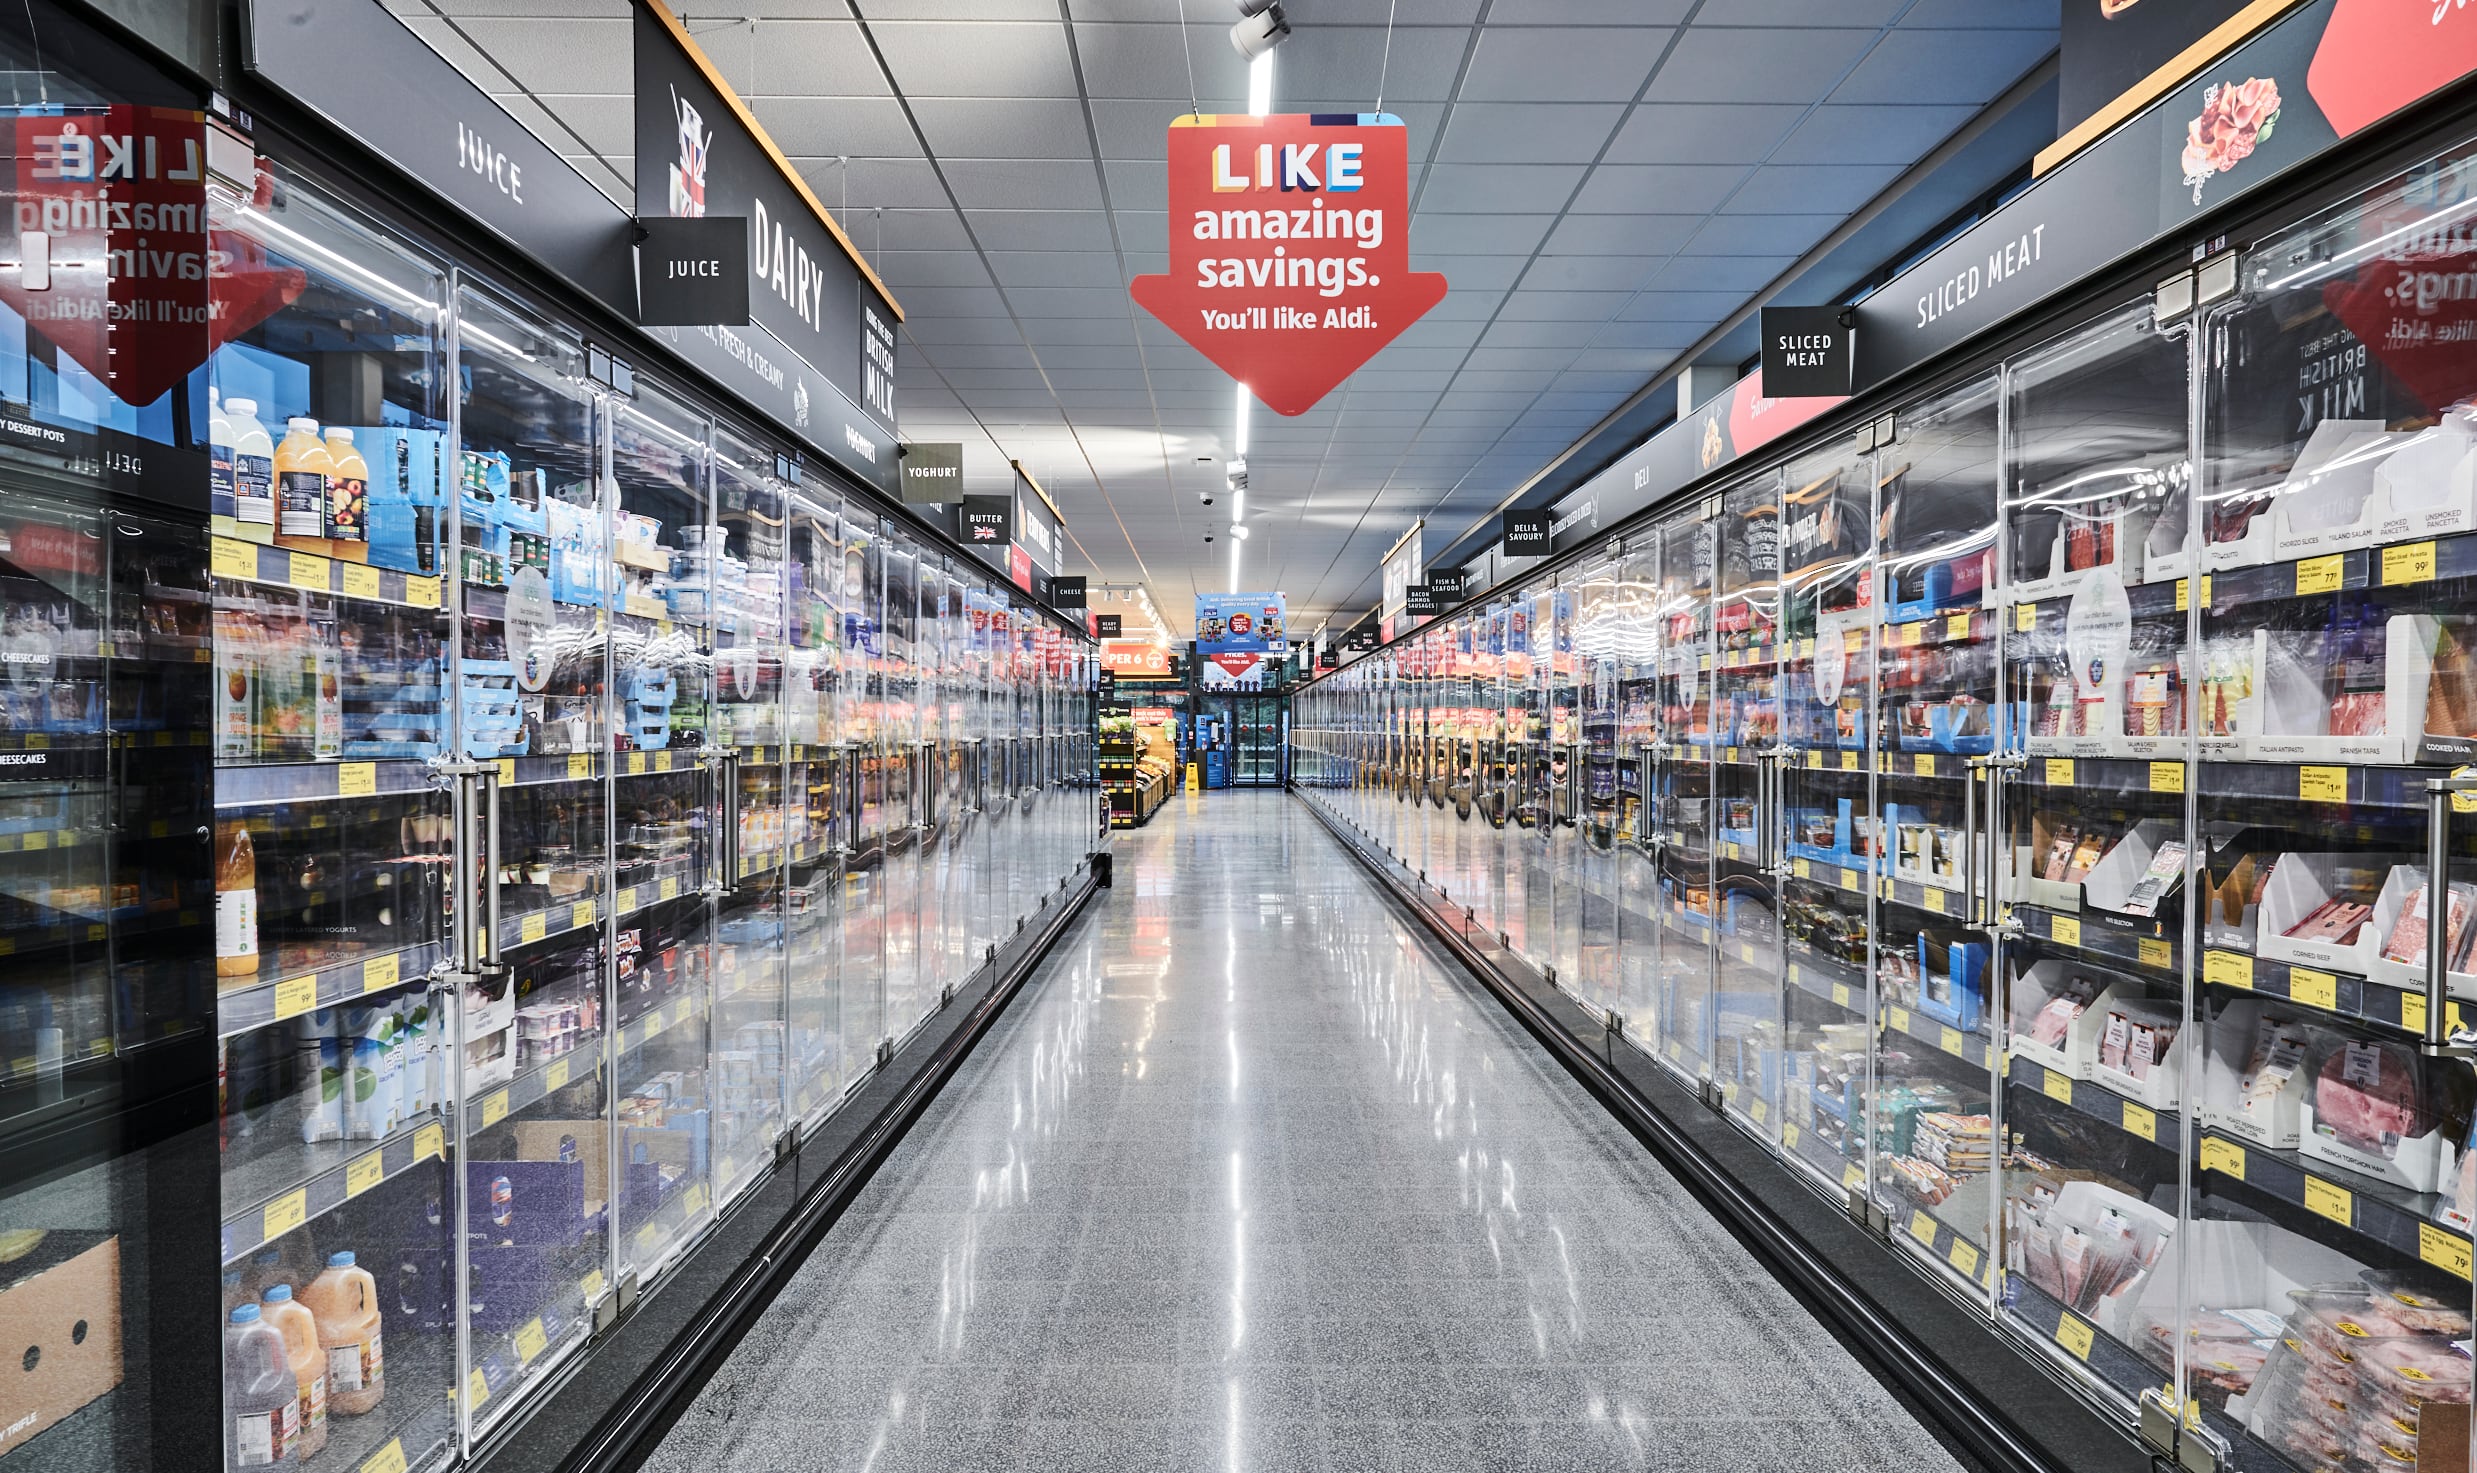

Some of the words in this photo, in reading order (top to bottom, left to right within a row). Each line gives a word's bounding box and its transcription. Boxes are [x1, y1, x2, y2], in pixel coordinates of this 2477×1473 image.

[458, 121, 523, 204] JUICE
[1213, 144, 1364, 192] LIKE
[1193, 198, 1382, 248] amazing
[668, 260, 721, 279] JUICE
[755, 198, 824, 334] DAIRY
[1197, 246, 1381, 297] savings.
[1916, 264, 1981, 330] SLICED
[1987, 223, 2047, 290] MEAT
[1201, 307, 1266, 330] You'll
[1273, 307, 1317, 329] like
[1323, 306, 1378, 329] Aldi.
[1779, 335, 1832, 350] SLICED
[718, 324, 746, 365] FRESH
[746, 346, 754, 370] &
[754, 352, 784, 391] CREAMY
[866, 329, 894, 378] BRITISH
[1786, 352, 1826, 366] MEAT
[866, 361, 895, 422] MILK
[7, 420, 42, 438] DESSERT
[43, 429, 65, 442] POTS
[845, 423, 876, 465] YOGHURT
[908, 467, 957, 479] YOGHURT
[1634, 465, 1649, 491] DELI
[969, 513, 1003, 524] BUTTER
[2383, 518, 2408, 528] SMOKED
[2425, 509, 2462, 521] UNSMOKED
[2427, 518, 2460, 529] PANCETTA
[1509, 532, 1543, 541] SAVOURY
[1514, 524, 1530, 532] DELI
[2351, 529, 2373, 538] SALAMI
[2380, 526, 2410, 536] PANCETTA
[1, 652, 50, 664] CHEESECAKES
[2278, 746, 2304, 754] ANTIPASTO
[2426, 743, 2453, 753] COOKED
[2292, 950, 2316, 959] CORNED
[2316, 953, 2331, 961] BEEF
[2321, 1146, 2342, 1160] FRENCH
[2342, 1154, 2371, 1170] TORCHON
[2372, 1164, 2386, 1174] HAM
[6, 1411, 38, 1437] TRIFLE
